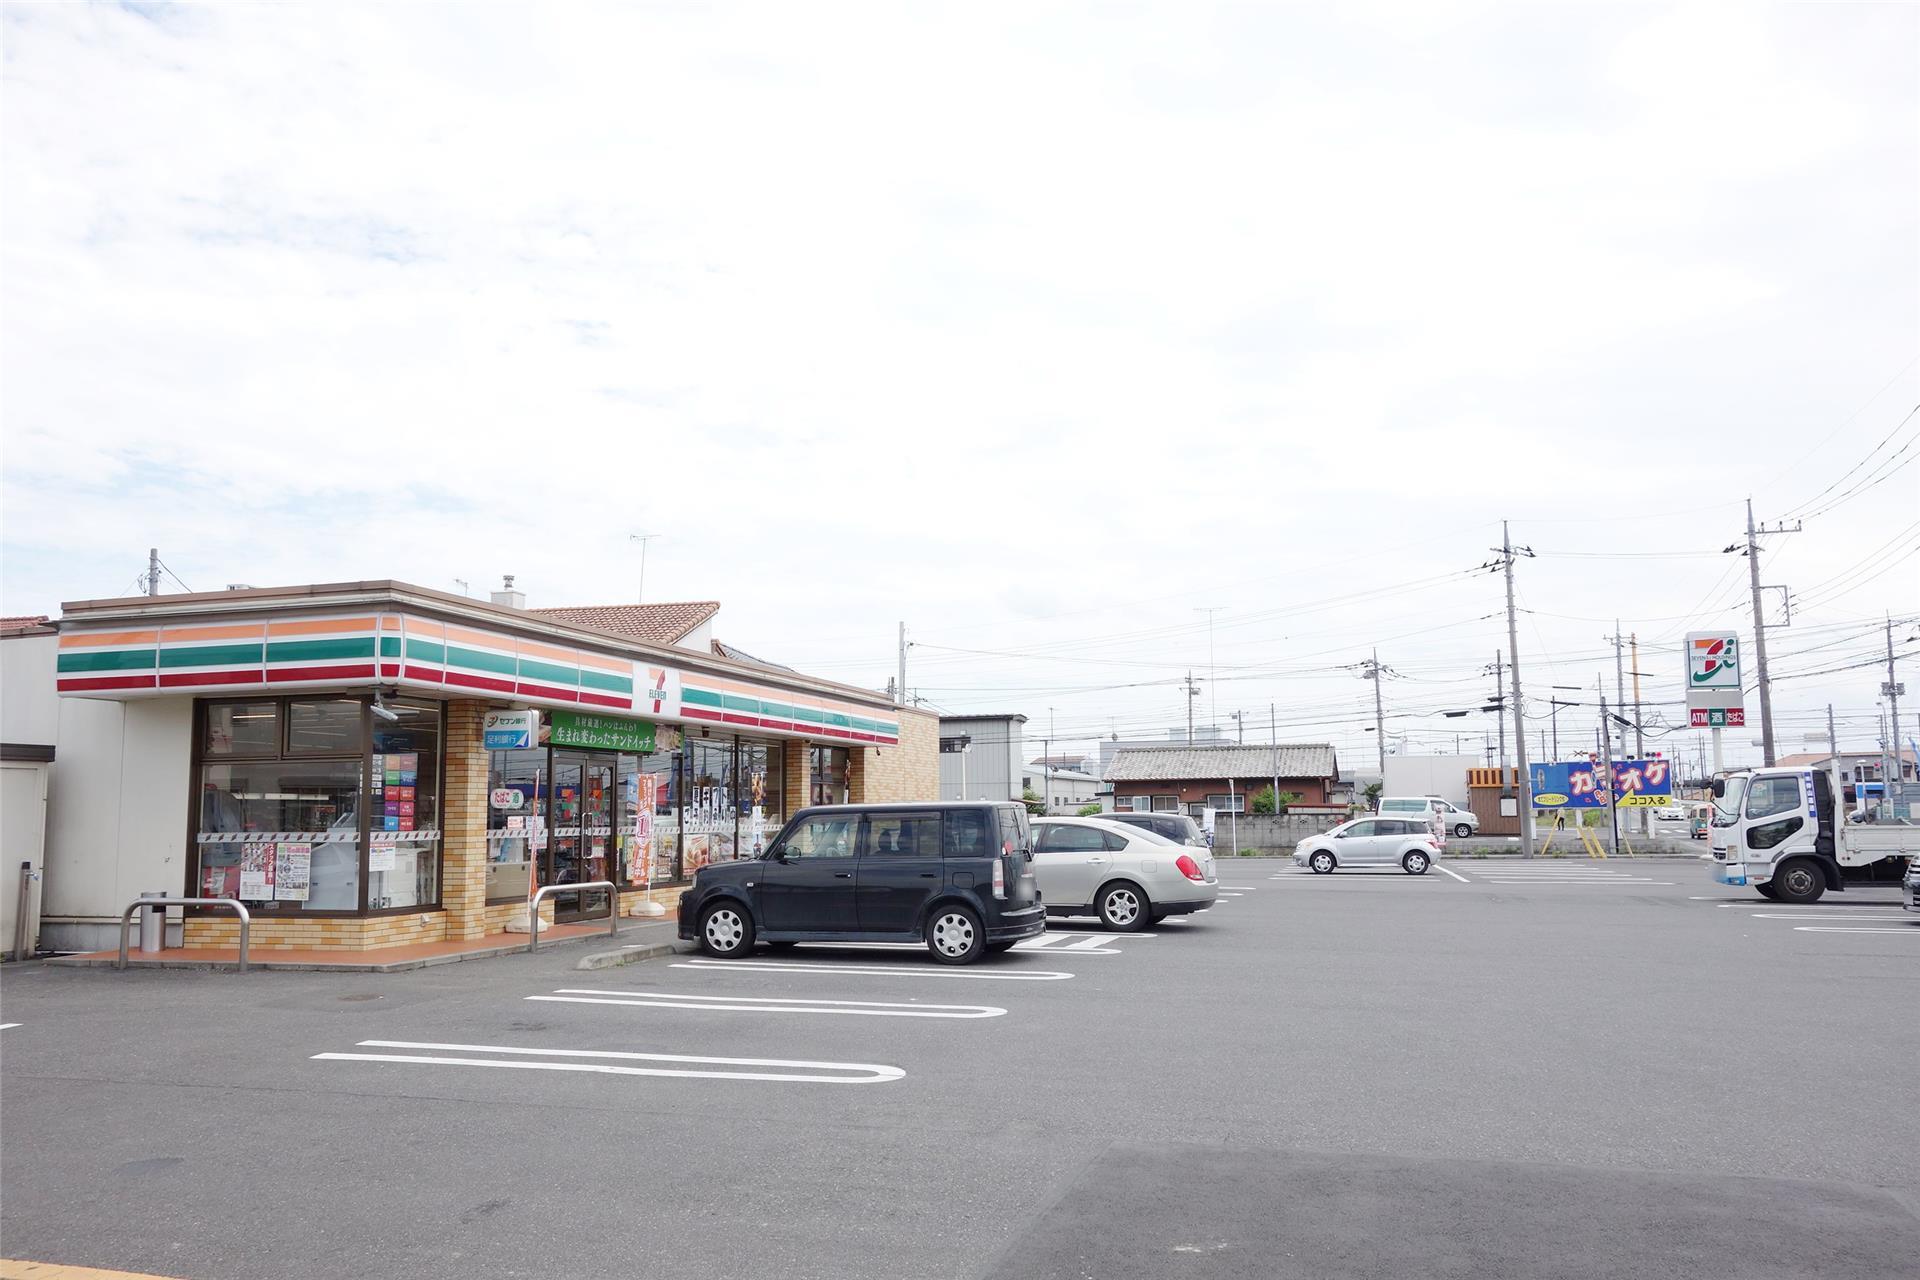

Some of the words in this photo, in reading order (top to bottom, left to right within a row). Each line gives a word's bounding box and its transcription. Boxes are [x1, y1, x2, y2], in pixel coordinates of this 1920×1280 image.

[648, 688, 667, 701] ELEVEN
[499, 717, 527, 726] セブン銀行
[1692, 712, 1708, 724] ATM
[1711, 711, 1723, 723] 酒
[1727, 711, 1744, 723] たばこ
[487, 734, 517, 745] 足利銀行
[556, 727, 652, 750] 生まれ変わったサンドイッチ
[1629, 796, 1667, 806] ココ入る
